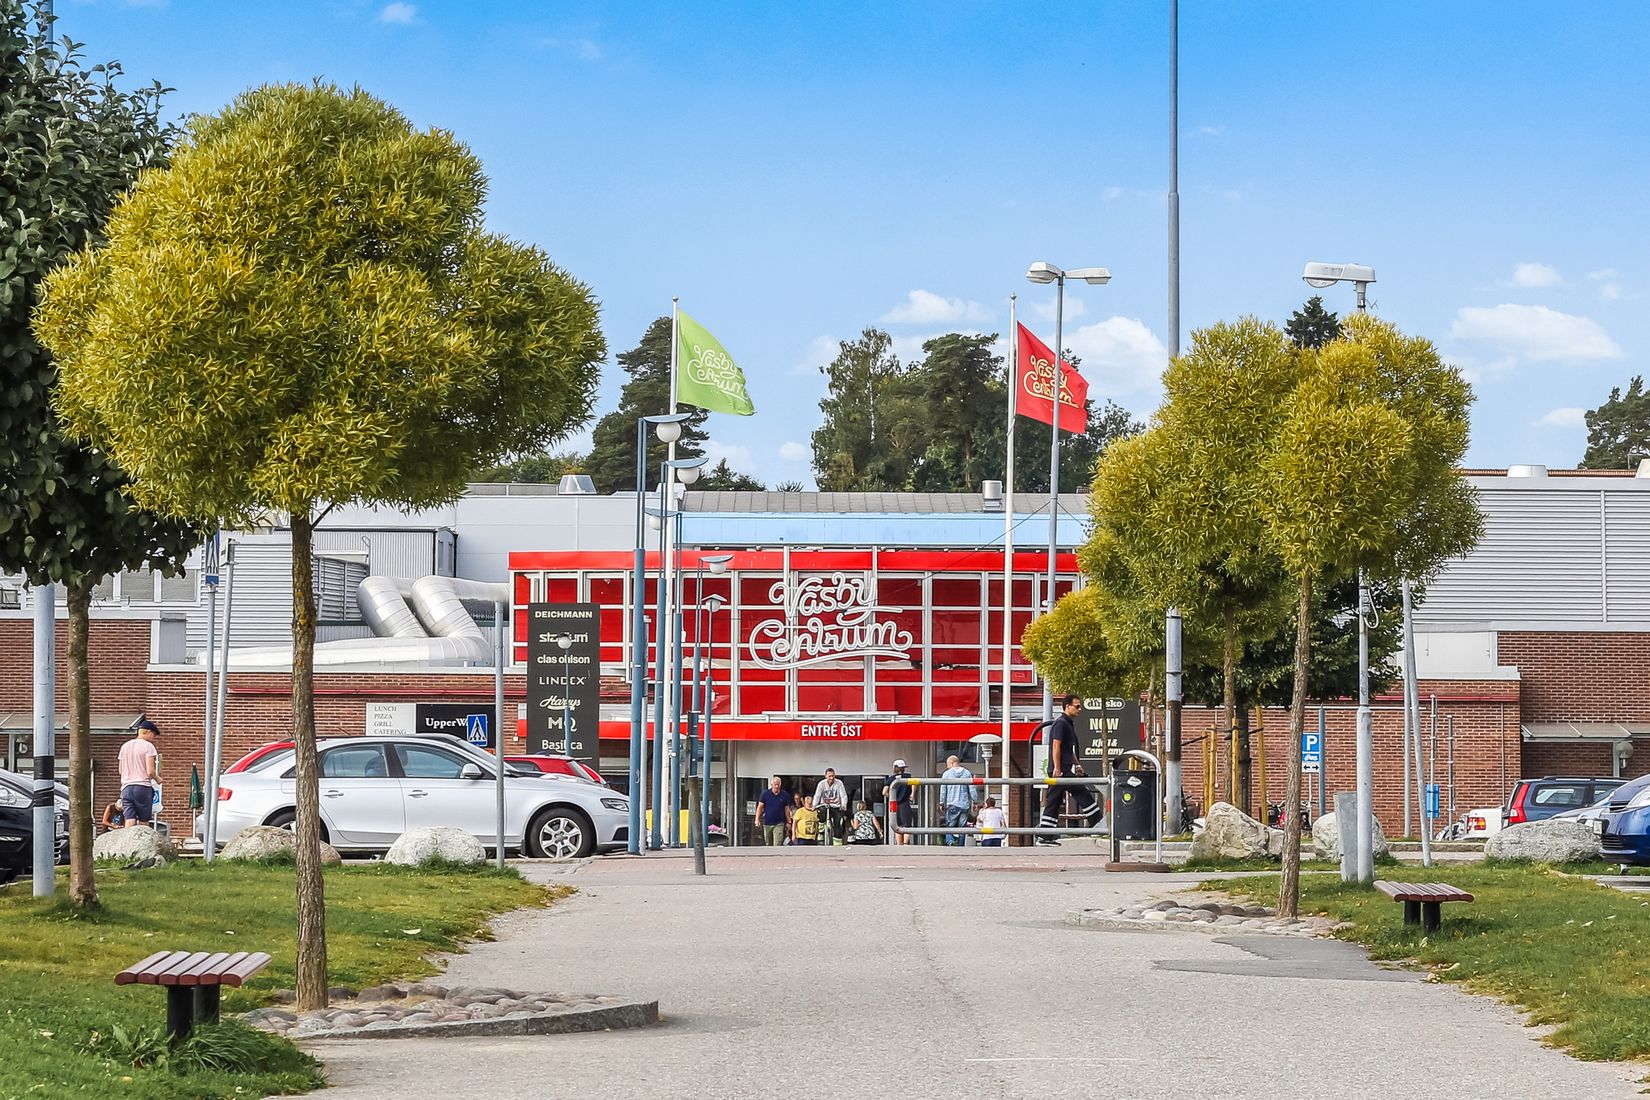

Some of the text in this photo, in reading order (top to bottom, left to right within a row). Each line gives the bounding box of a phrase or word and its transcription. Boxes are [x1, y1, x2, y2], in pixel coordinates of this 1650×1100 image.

[769, 572, 902, 626] Väsby
[750, 617, 913, 669] Centrum
[537, 654, 557, 664] clas
[539, 676, 585, 685] LINDEX
[801, 722, 863, 737] ENTRÉ ÖST
[542, 739, 583, 750] Basilca
[1306, 735, 1318, 751] P
[1085, 747, 1124, 756] Comany
